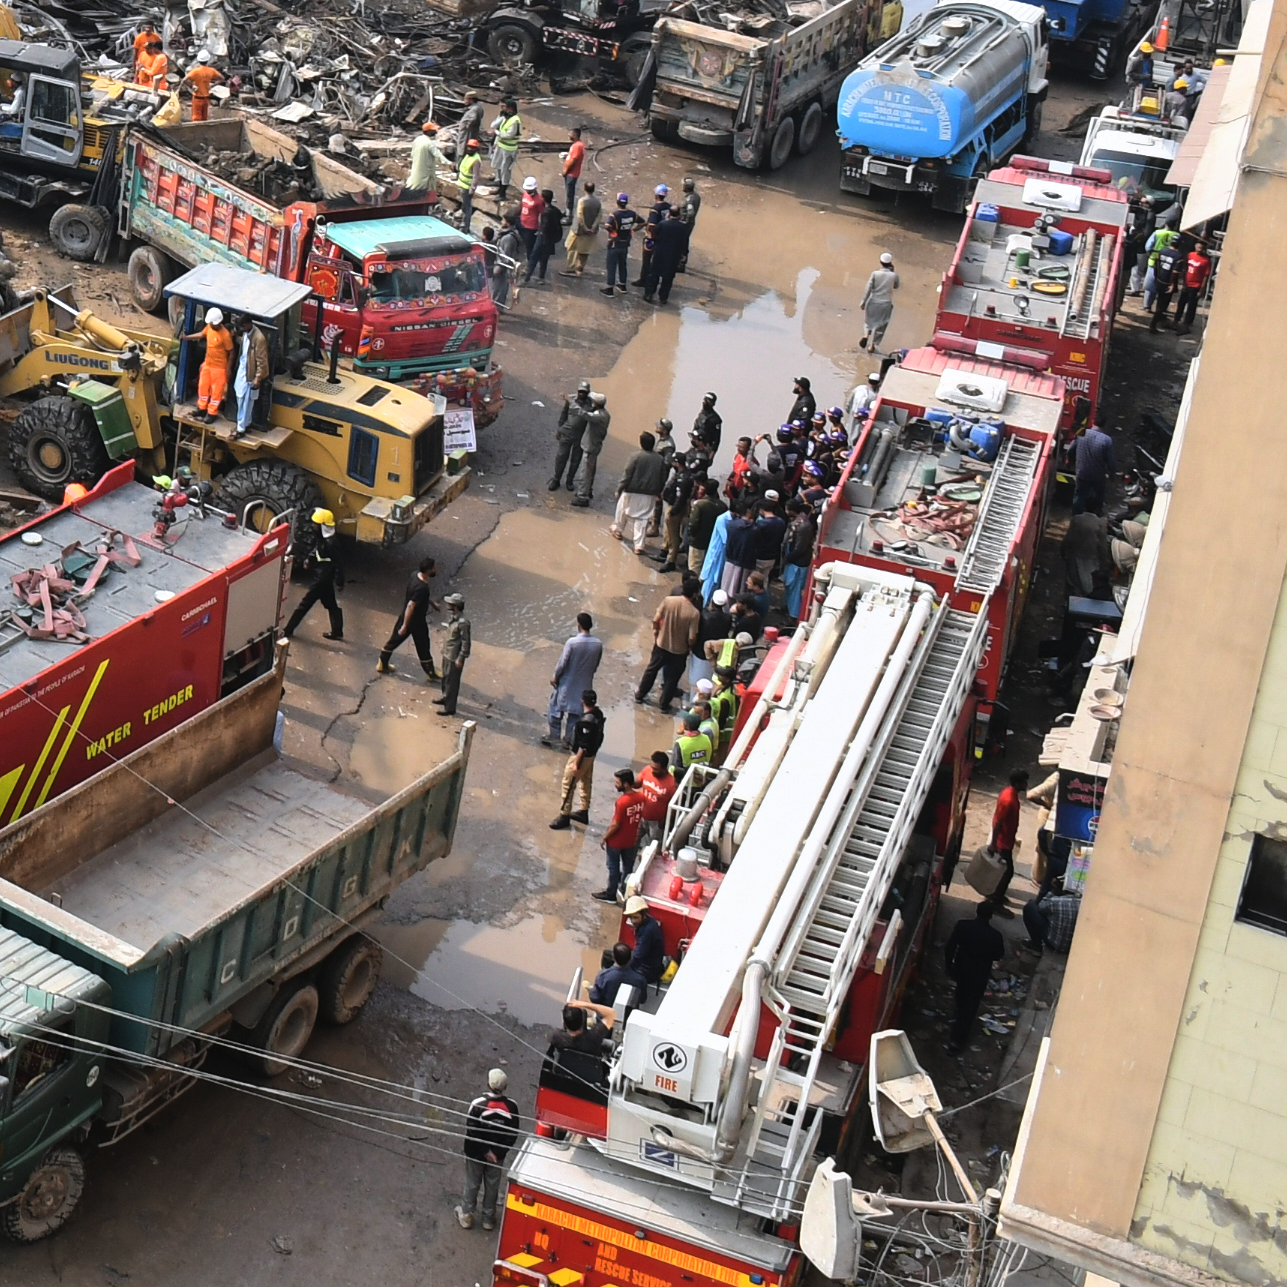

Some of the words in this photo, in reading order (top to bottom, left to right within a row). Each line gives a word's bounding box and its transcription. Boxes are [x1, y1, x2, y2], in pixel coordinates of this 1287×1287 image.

[394, 323, 435, 331] NISSAN
[440, 318, 478, 327] DIESEL
[86, 721, 132, 760] WATER
[143, 683, 194, 725] TENDER
[655, 1074, 678, 1092] FIRE
[534, 1231, 550, 1250] HQ
[536, 1204, 577, 1229] KARACHI
[578, 1217, 648, 1252] METROPOLITAN
[650, 1239, 719, 1277] CORPORATION
[717, 1267, 741, 1285] FIRE
[597, 1243, 618, 1260] AND
[594, 1258, 631, 1282] RESCUE
